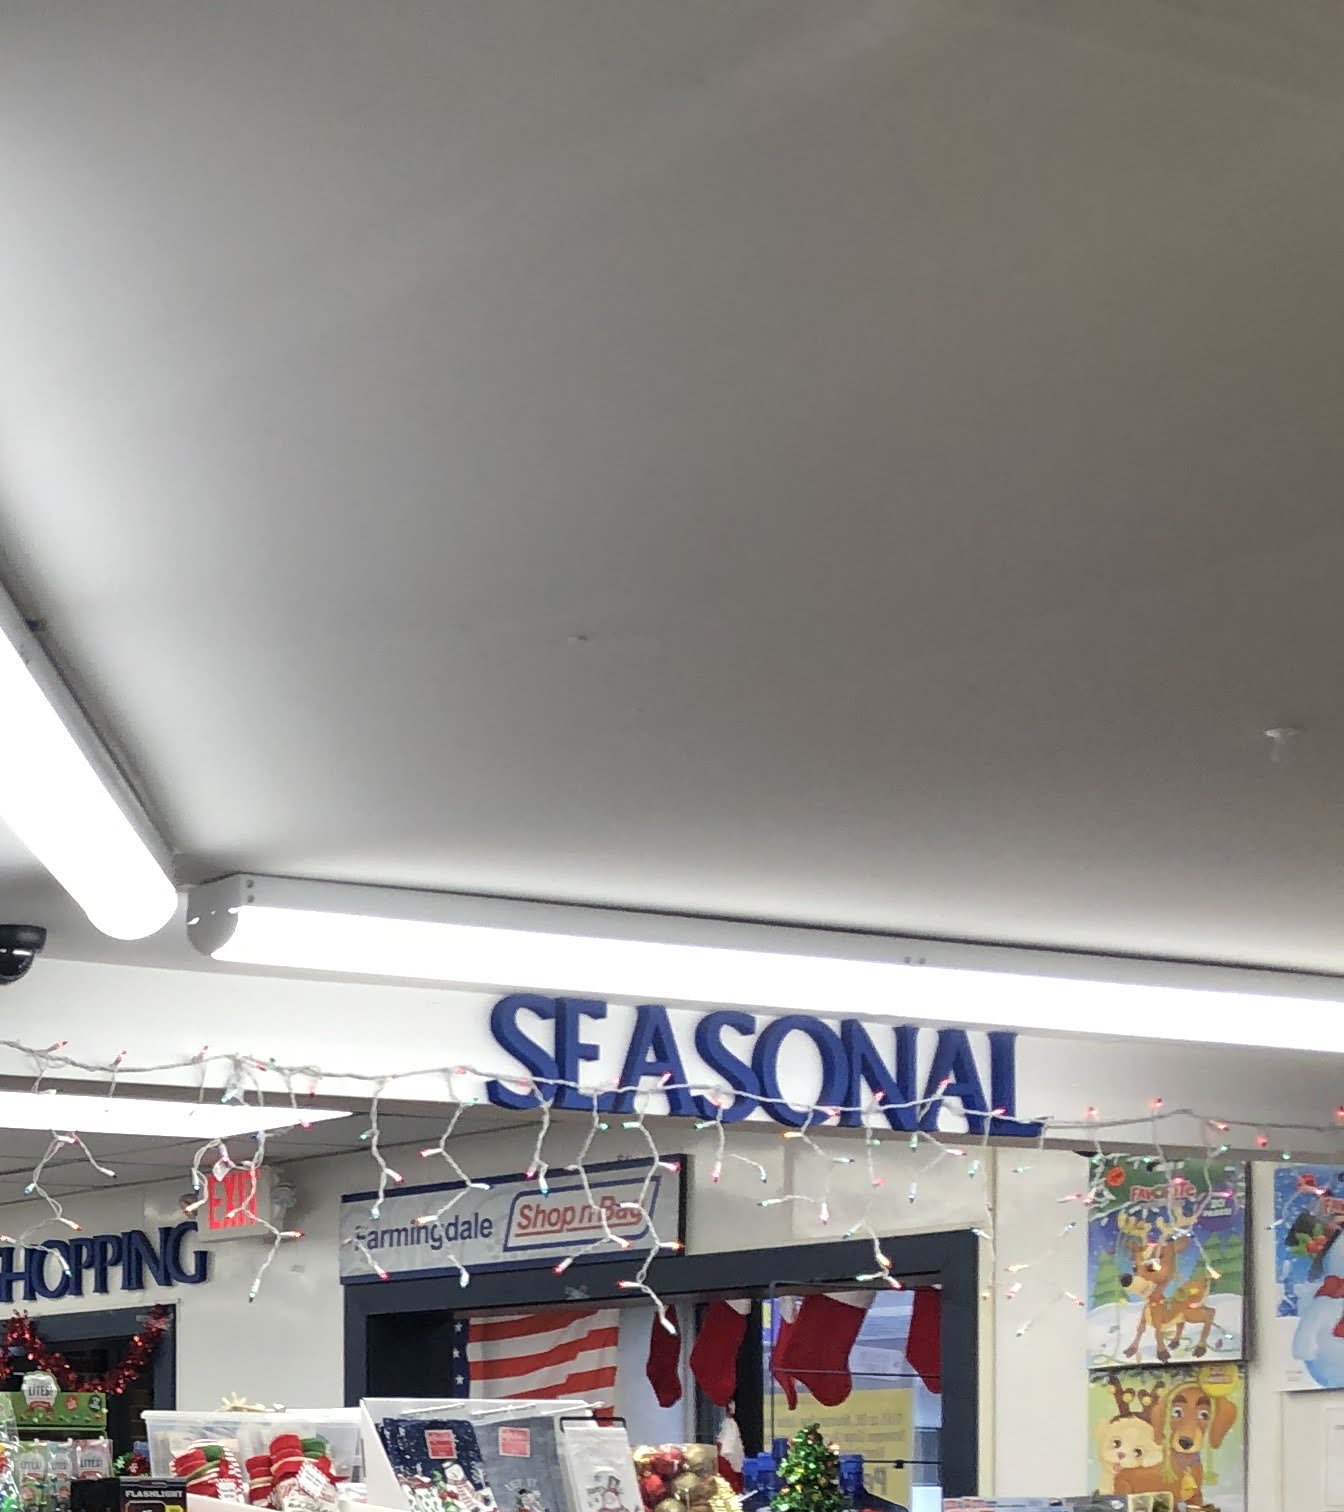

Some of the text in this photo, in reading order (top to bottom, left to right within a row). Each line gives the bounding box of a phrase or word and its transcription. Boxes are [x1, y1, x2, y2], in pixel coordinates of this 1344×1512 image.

[485, 993, 1043, 1138] SEASONAL
[208, 1169, 259, 1229] EXIT
[354, 1212, 493, 1252] Farmingdale
[517, 1203, 576, 1232] Shop
[124, 1490, 184, 1499] FLASHLIGHT
